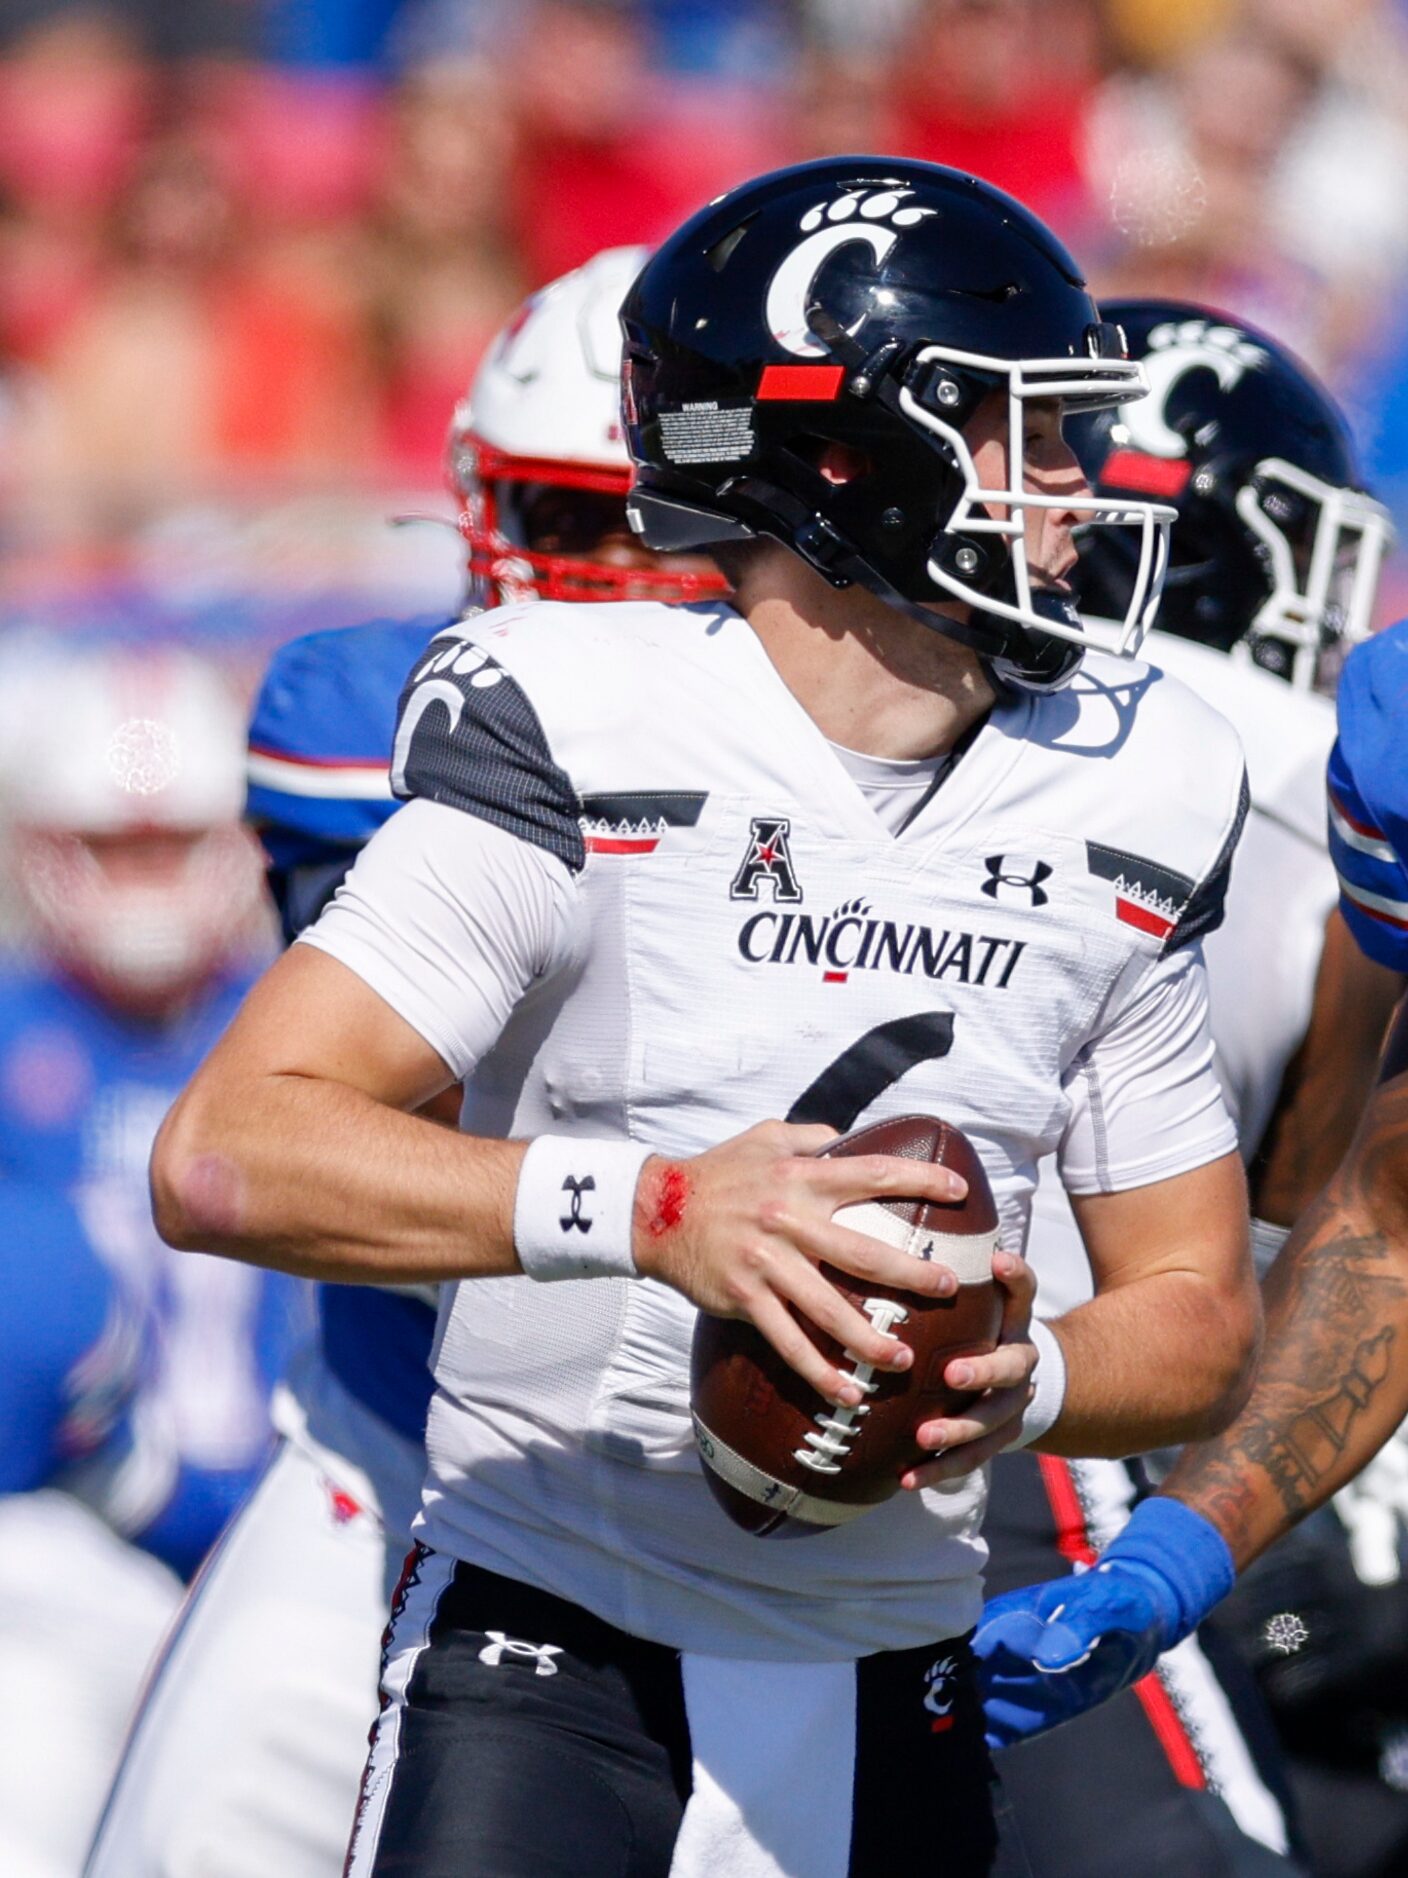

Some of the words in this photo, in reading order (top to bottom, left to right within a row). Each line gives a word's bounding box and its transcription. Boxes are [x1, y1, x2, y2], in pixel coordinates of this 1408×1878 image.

[682, 401, 719, 412] WARNING
[729, 817, 804, 904] A
[738, 905, 1030, 990] CINCINNATI
